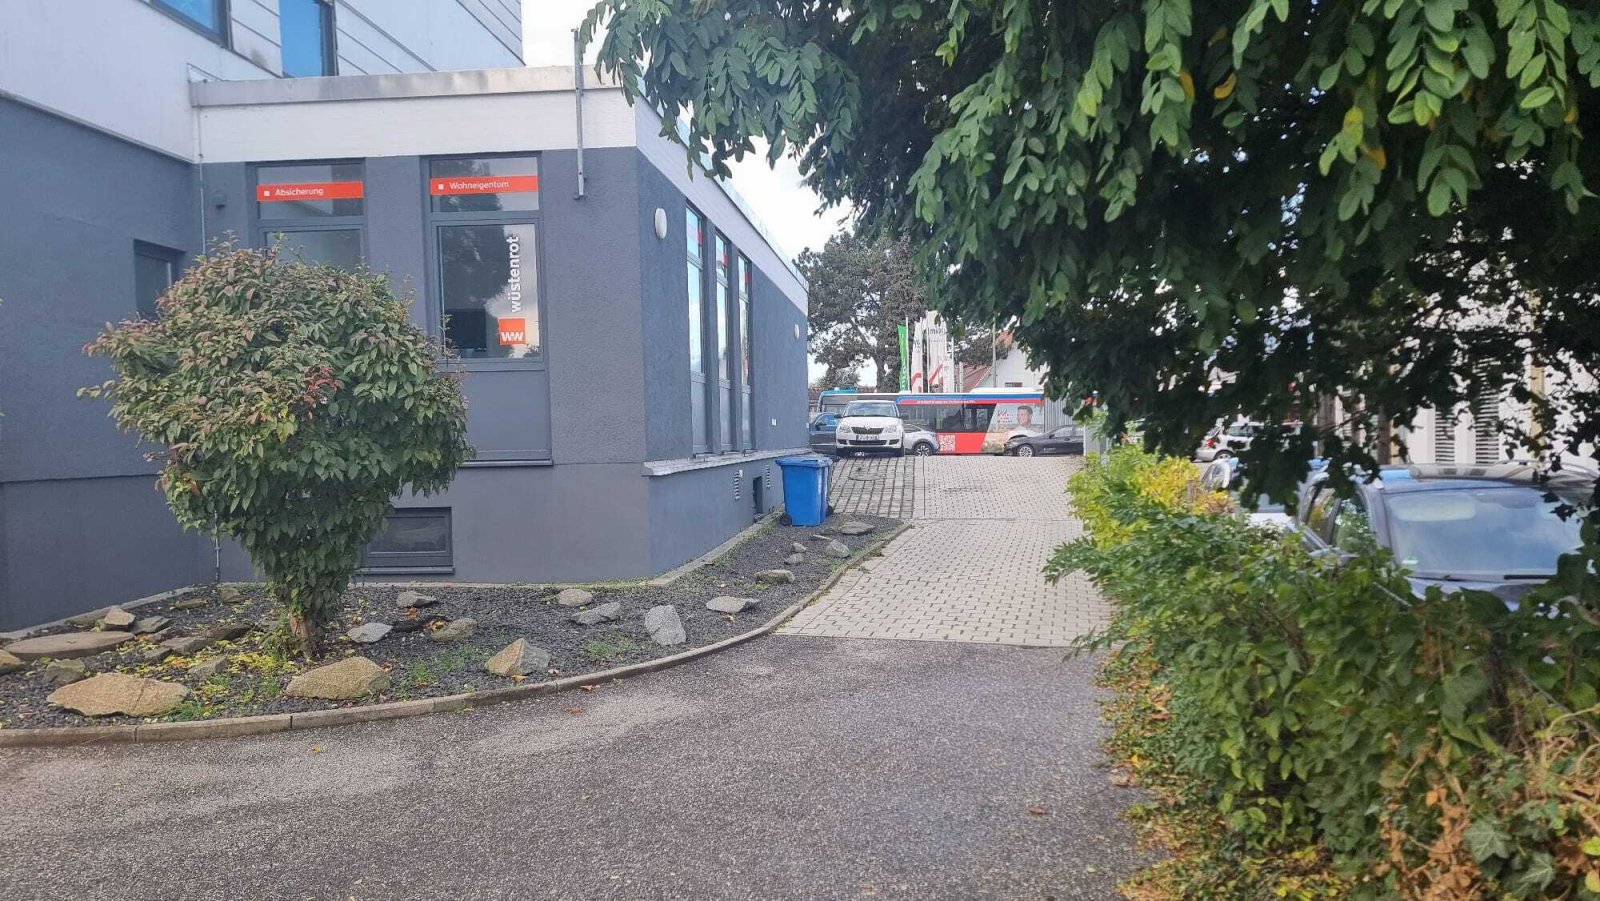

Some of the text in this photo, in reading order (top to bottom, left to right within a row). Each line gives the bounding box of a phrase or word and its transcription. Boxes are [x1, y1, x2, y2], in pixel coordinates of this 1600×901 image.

[449, 180, 509, 191] Wohneigentum
[275, 187, 324, 198] Absicherung
[506, 236, 521, 313] wüstenrot
